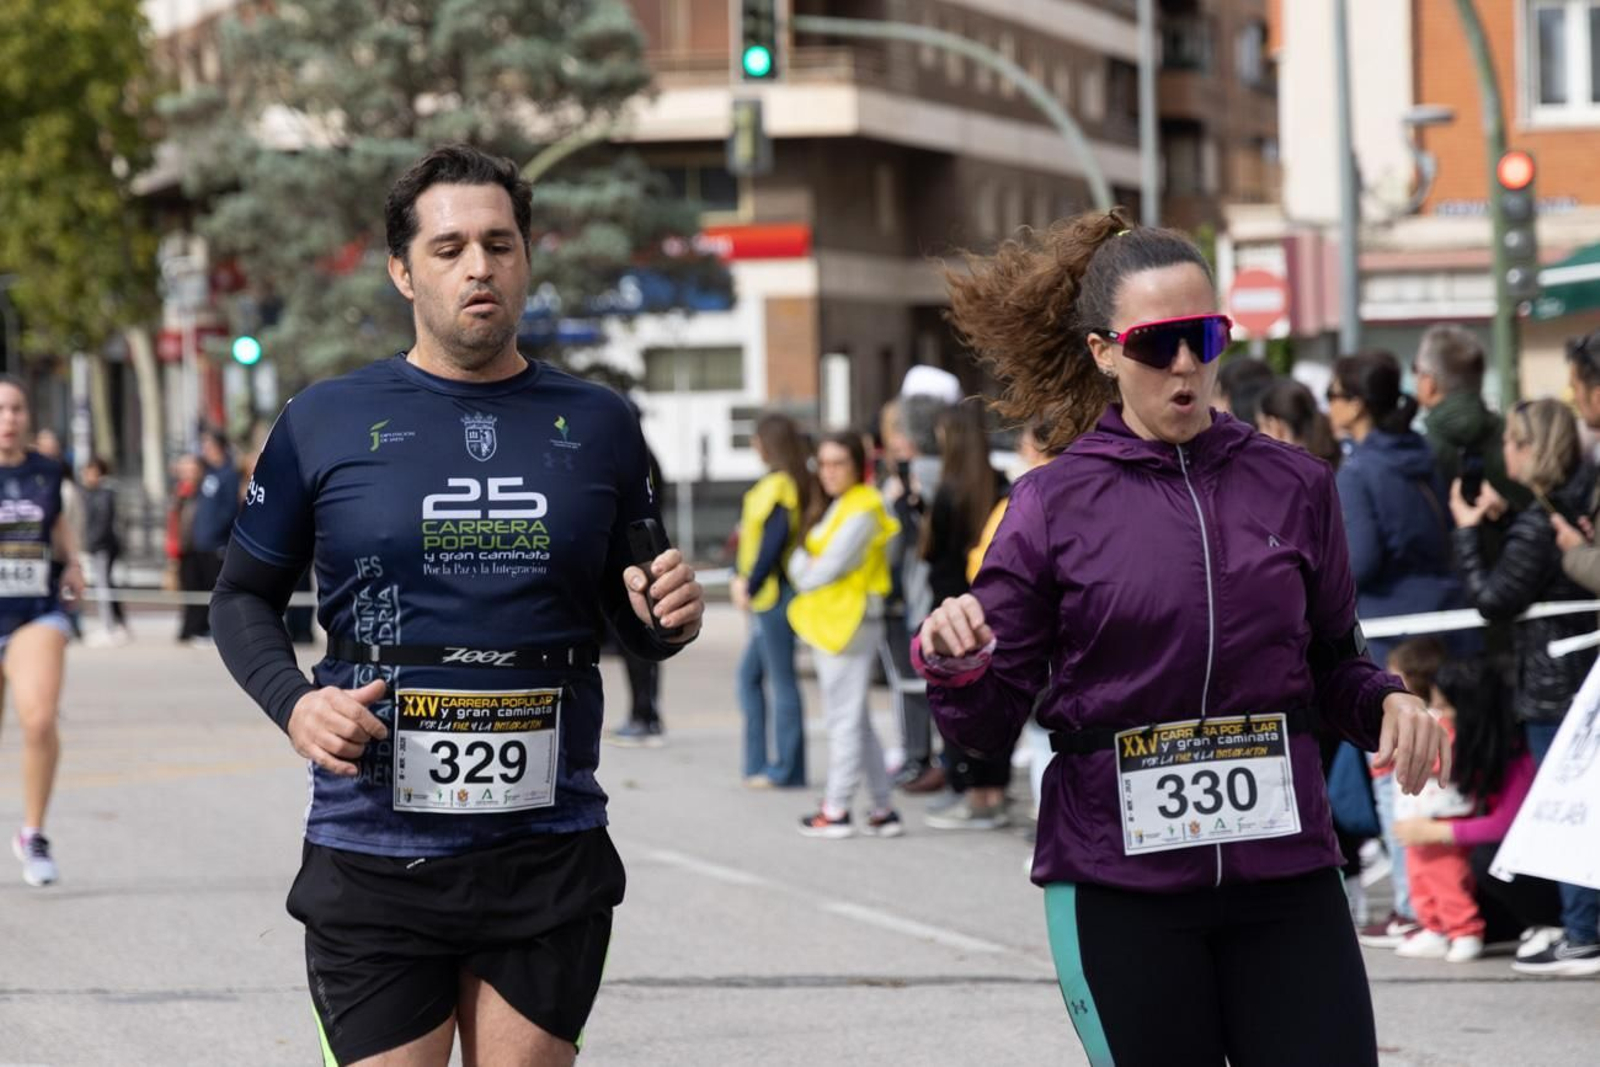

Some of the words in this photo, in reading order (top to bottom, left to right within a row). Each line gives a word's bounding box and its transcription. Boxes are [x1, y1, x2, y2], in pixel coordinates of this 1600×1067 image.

[422, 477, 548, 519] 25
[422, 520, 548, 534] CARRERA
[424, 535, 551, 550] POPULAR
[424, 552, 435, 562] y
[439, 552, 474, 562] gran
[479, 550, 551, 560] caminata
[423, 563, 440, 575] Por
[442, 563, 451, 574] la
[455, 563, 470, 574] Paz
[481, 563, 489, 574] la
[403, 696, 438, 717] XXV
[441, 698, 499, 708] CARRERA
[501, 696, 554, 708] POPULAR
[441, 708, 449, 719] y
[457, 708, 490, 719] gran
[497, 705, 552, 718] caminata
[1123, 732, 1158, 758] XXV
[1160, 728, 1218, 741] CARRRA
[1220, 722, 1278, 735] POPLAR
[1161, 741, 1170, 753] y
[1177, 737, 1210, 751] gran
[1217, 732, 1279, 745] caminata
[429, 740, 527, 785] 329
[1156, 767, 1258, 819] 330
